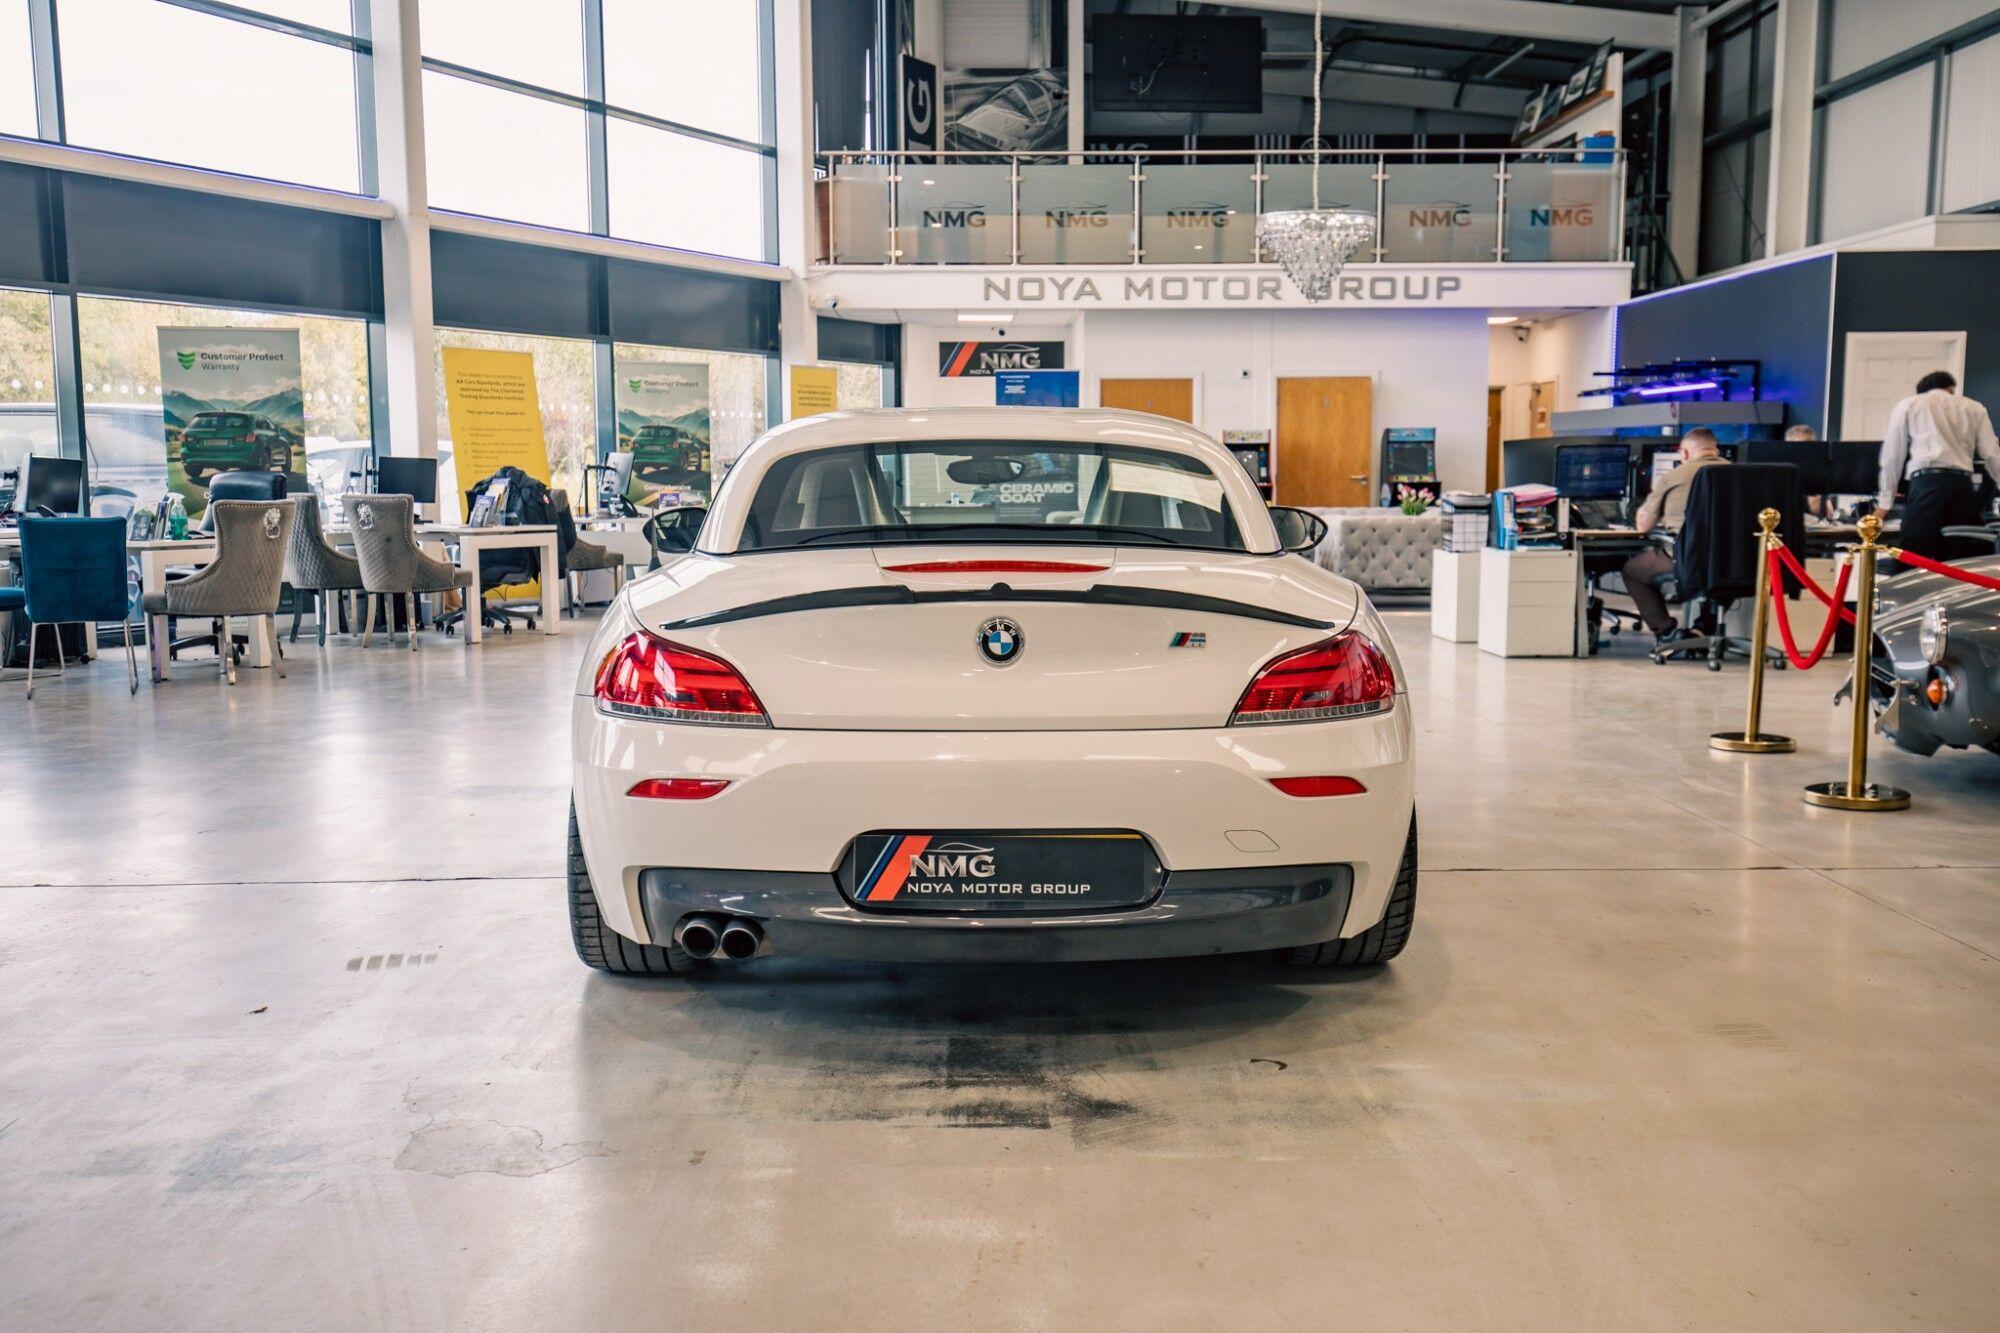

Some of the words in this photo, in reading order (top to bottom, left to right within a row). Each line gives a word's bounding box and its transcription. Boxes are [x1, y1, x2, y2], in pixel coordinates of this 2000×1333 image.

[923, 210, 987, 229] NMG
[1045, 210, 1109, 229] NMG
[1166, 210, 1232, 229] NMG
[1408, 208, 1473, 228] NMG
[1529, 207, 1594, 227] NMG
[983, 276, 1102, 301] NOYA
[1124, 276, 1282, 301] MOTOR
[200, 352, 246, 361] Customer
[249, 352, 284, 361] Protect
[979, 352, 1041, 369] NMG
[201, 362, 240, 371] Warranty
[1000, 483, 1074, 494] CERAMIC
[1000, 493, 1045, 503] COAT
[908, 855, 995, 878] NMG
[907, 883, 954, 894] NOYA
[961, 883, 1022, 894] MOTOR
[1030, 884, 1090, 895] GROUP
